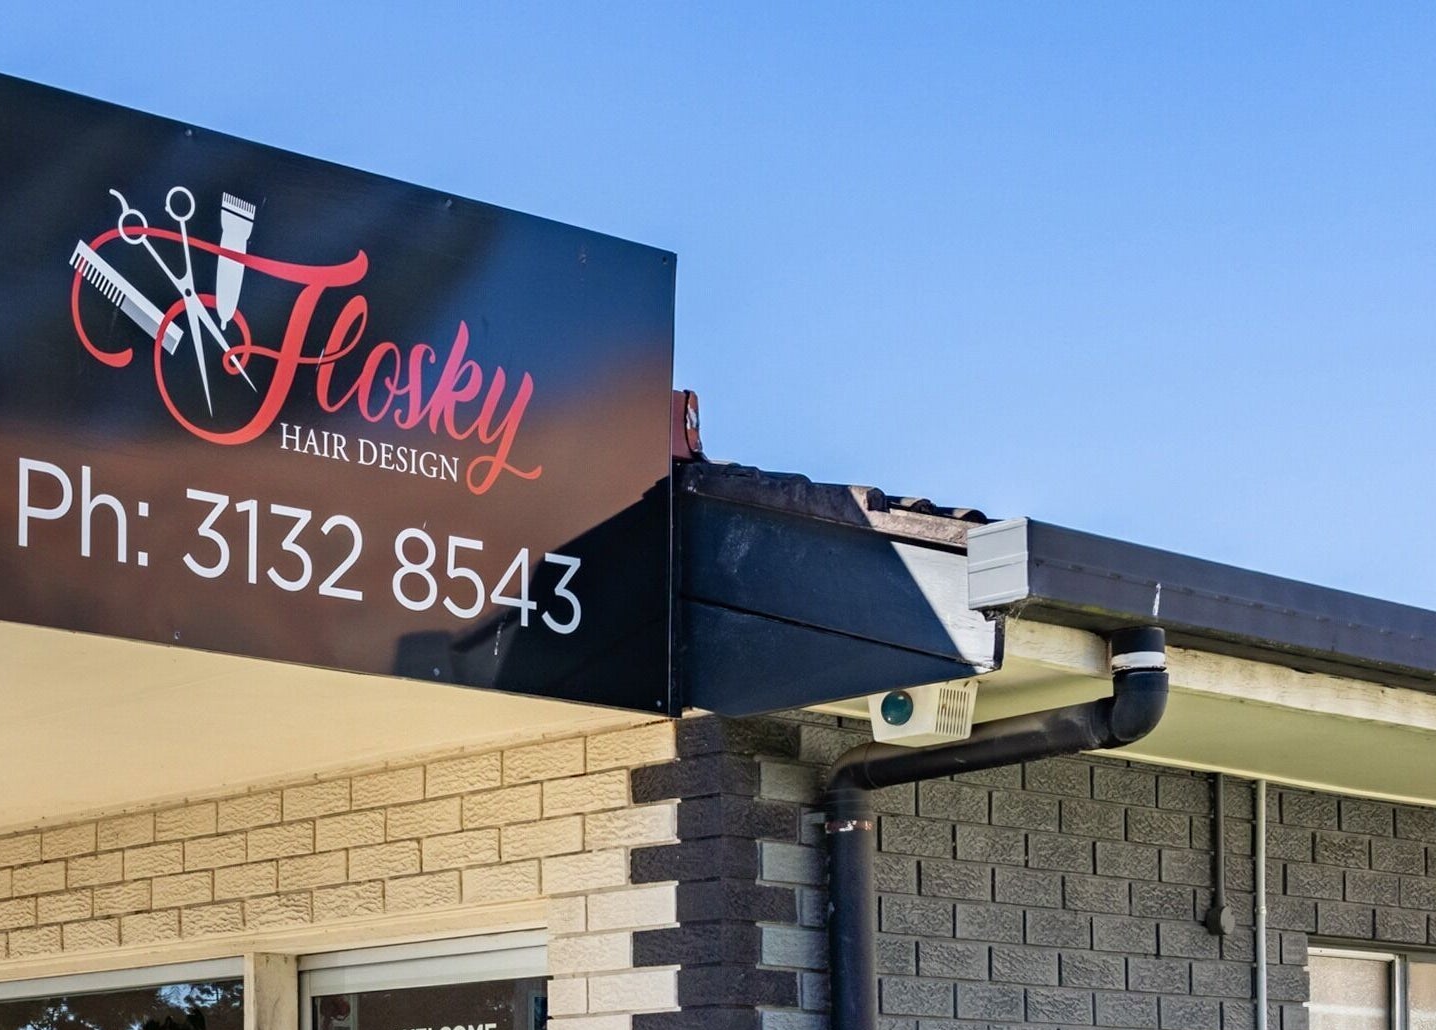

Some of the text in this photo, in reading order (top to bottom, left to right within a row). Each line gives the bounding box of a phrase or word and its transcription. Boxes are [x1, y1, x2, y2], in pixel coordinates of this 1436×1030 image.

[279, 422, 459, 483] HAIR DESIGN
[17, 457, 582, 635] Ph: 3132 8543
